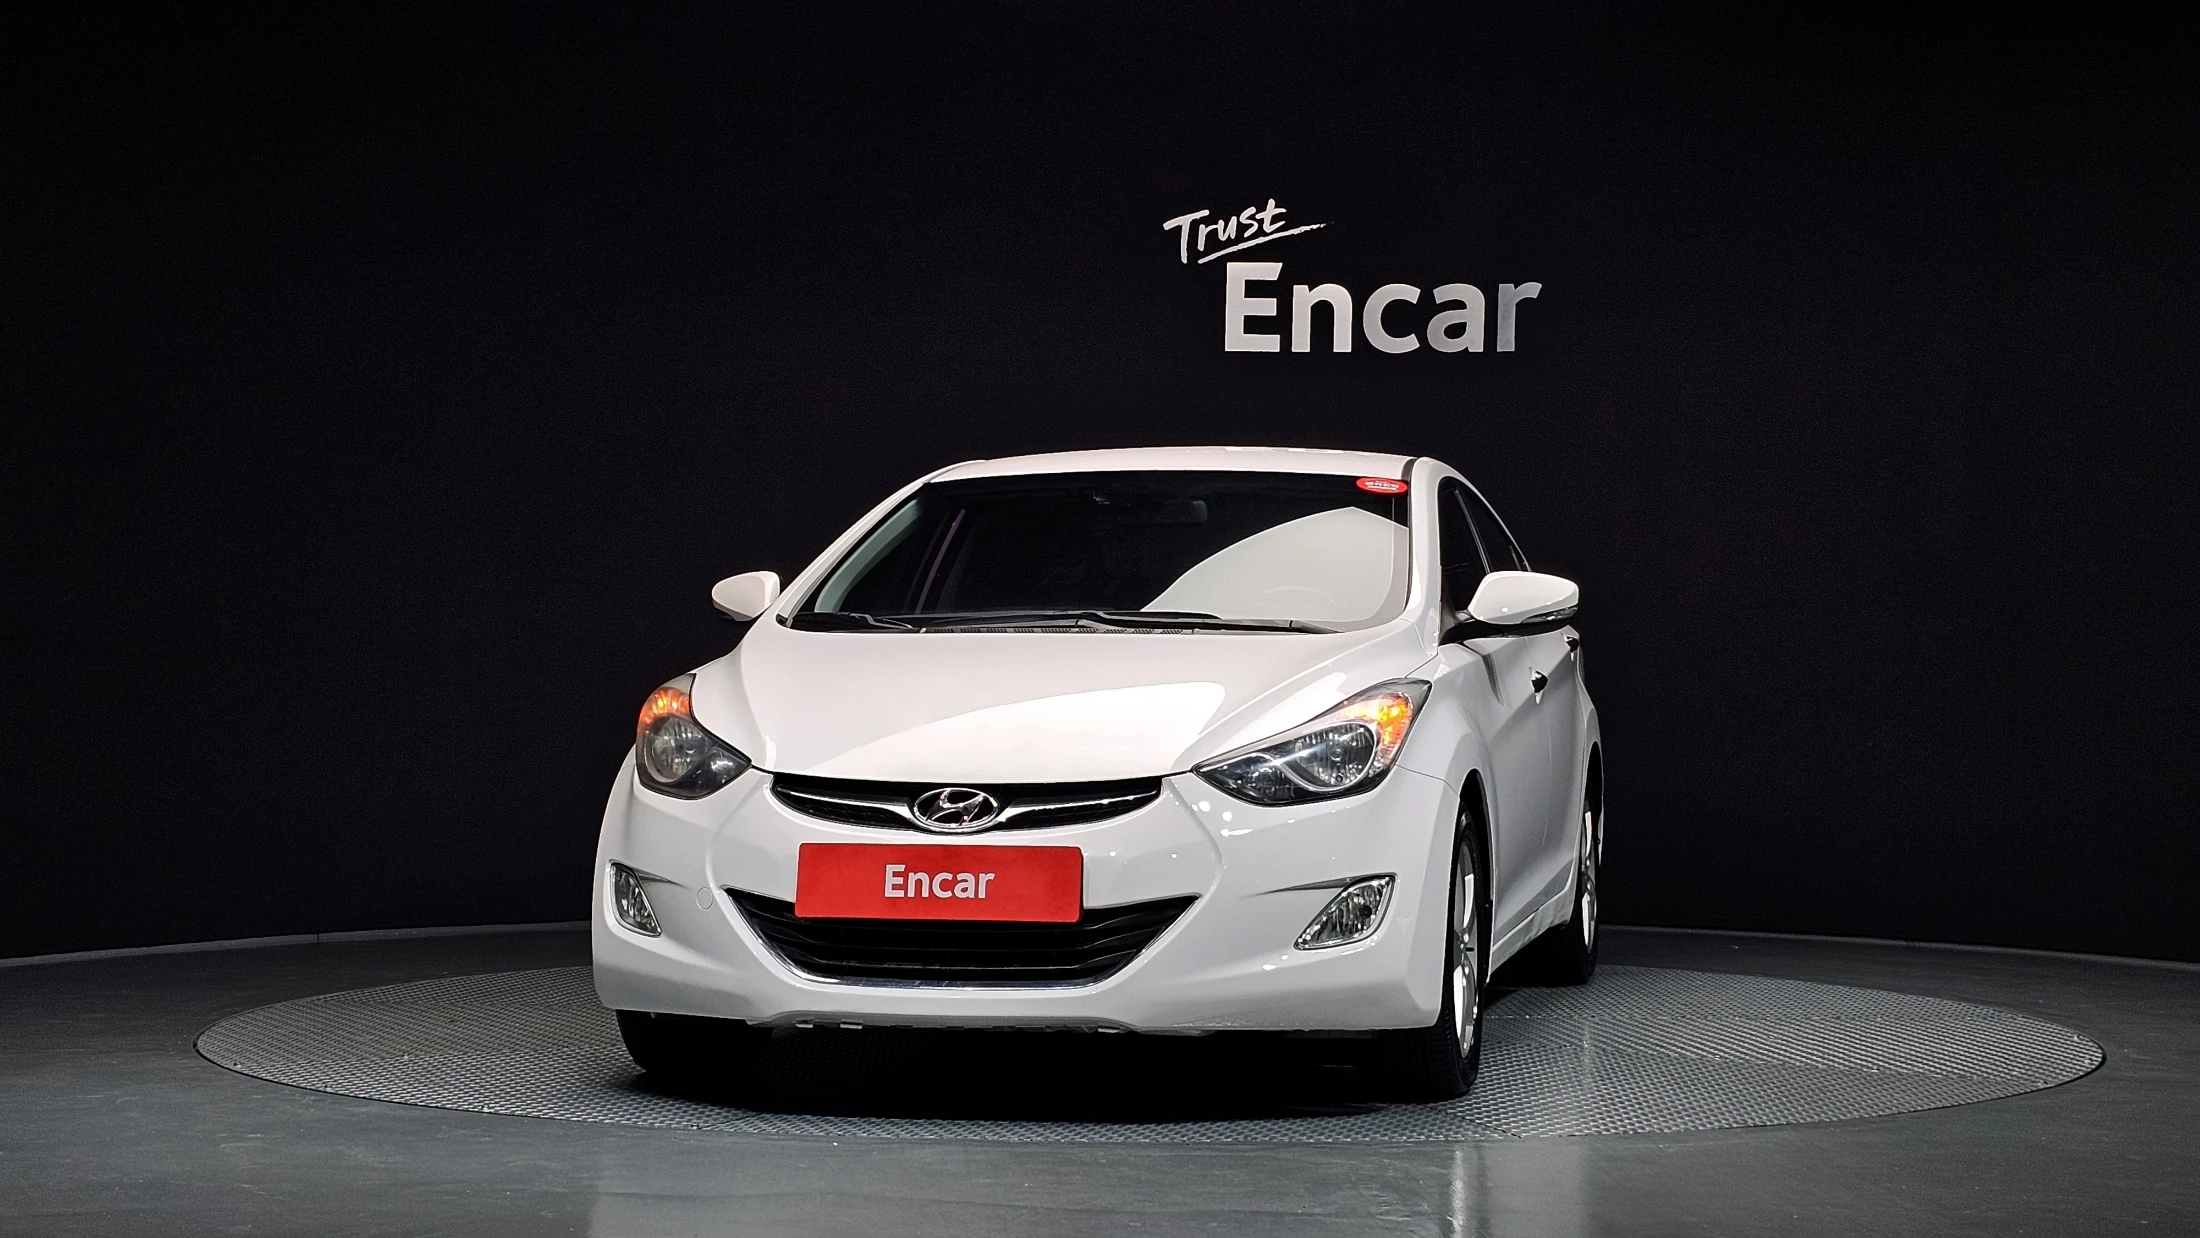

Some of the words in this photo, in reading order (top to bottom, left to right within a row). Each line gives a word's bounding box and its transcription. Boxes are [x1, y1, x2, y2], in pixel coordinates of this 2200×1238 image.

[1163, 199, 1287, 263] Trust
[1225, 262, 1542, 353] Encar
[884, 864, 995, 899] Encar
